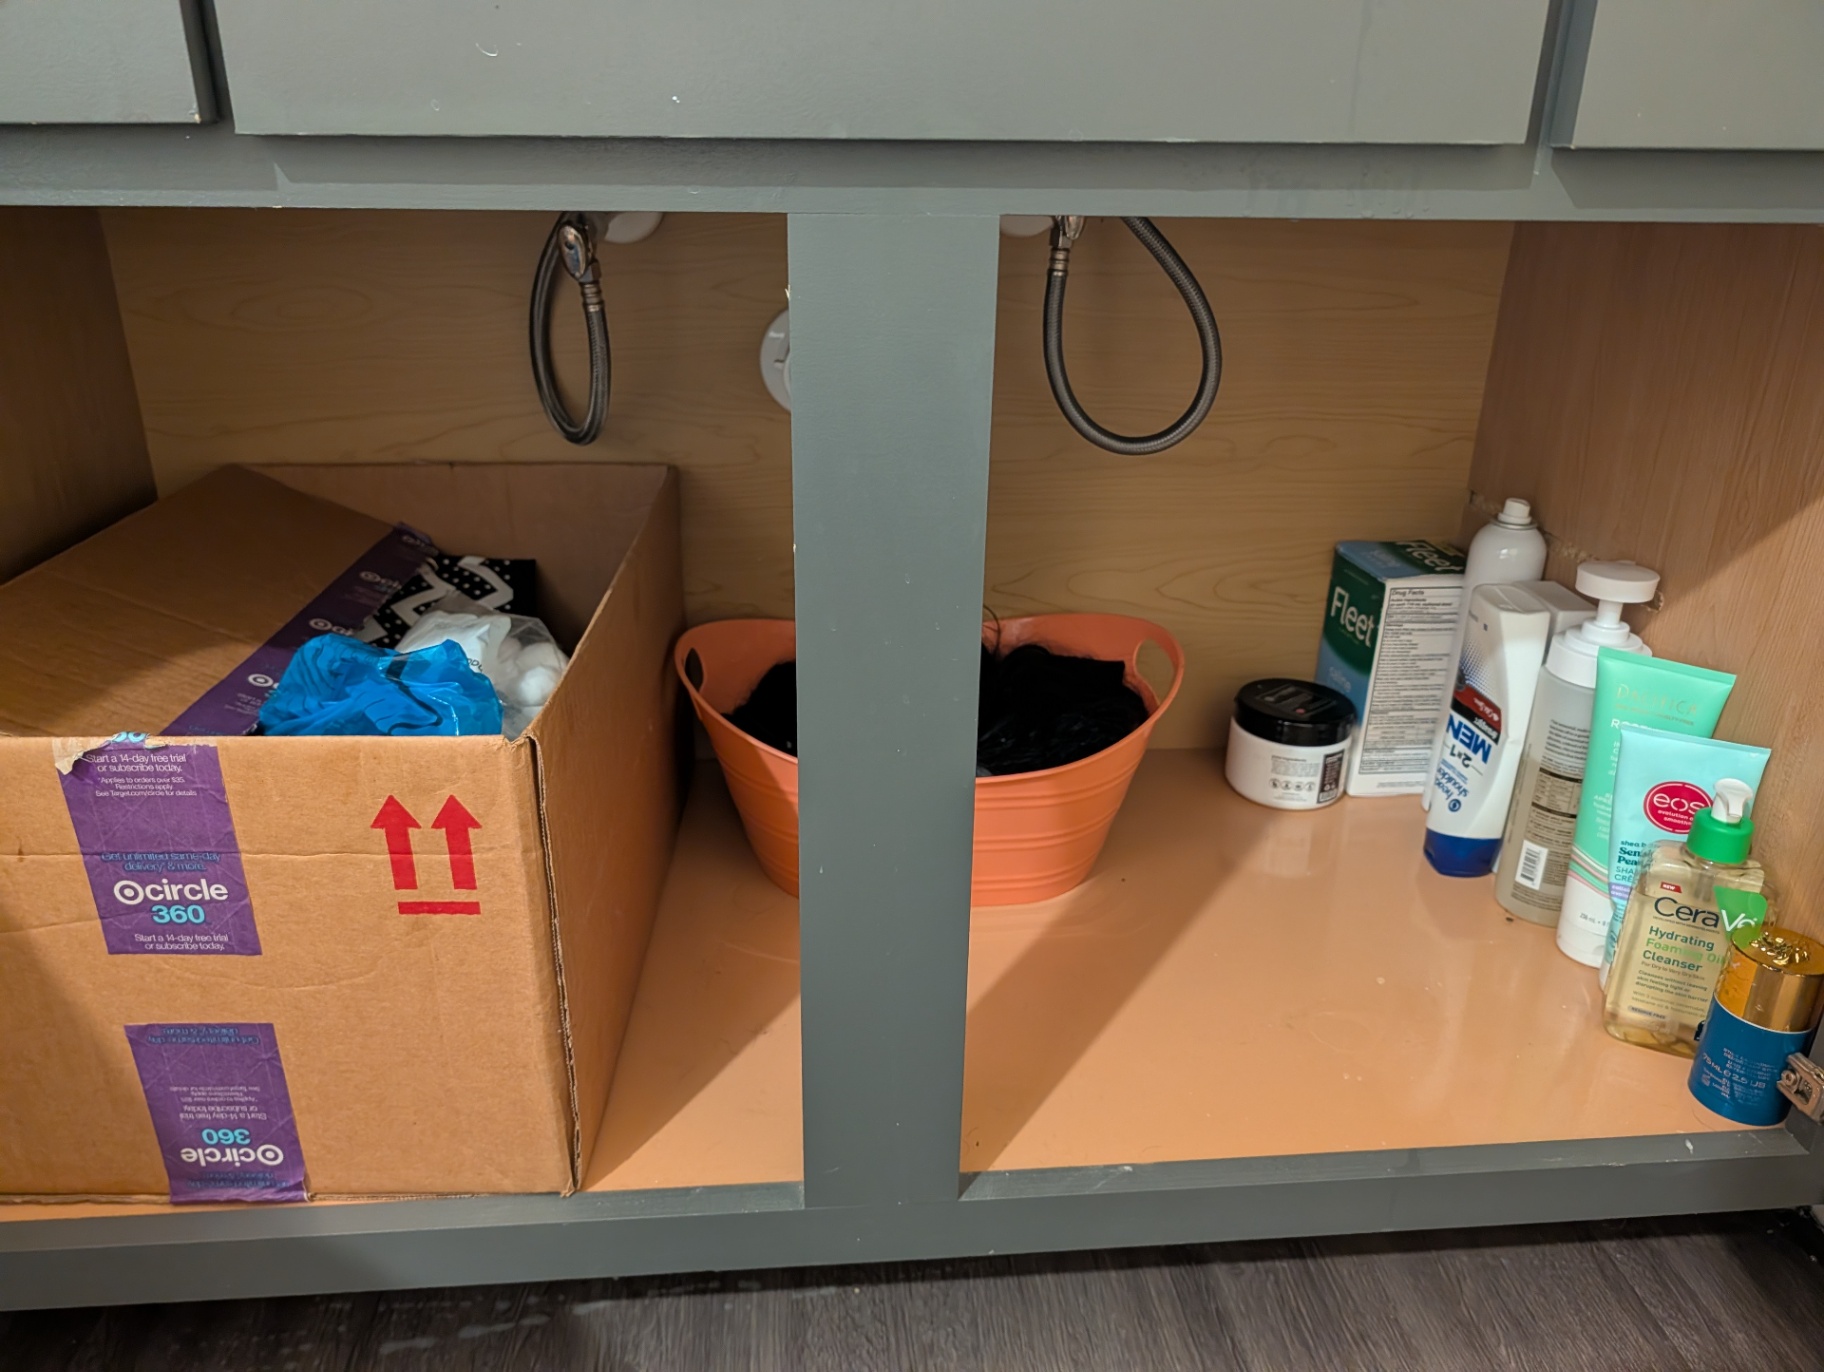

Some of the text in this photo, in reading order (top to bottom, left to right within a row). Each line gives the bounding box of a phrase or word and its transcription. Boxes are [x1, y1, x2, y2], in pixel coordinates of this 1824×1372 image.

[1330, 586, 1375, 649] Fleet
[1446, 713, 1492, 765] MEN
[86, 754, 109, 763] Start
[120, 754, 149, 765] 14-day
[151, 754, 169, 763] free
[170, 753, 186, 763] trial
[109, 763, 154, 773] subscribe
[1653, 793, 1705, 815] eos
[1657, 810, 1689, 820] evolution
[145, 878, 228, 901] circle
[1662, 883, 1676, 891] NEW
[152, 904, 205, 925] 360
[134, 934, 156, 942] Start
[166, 934, 194, 943] 14-day
[195, 934, 212, 942] free
[213, 934, 228, 942] trial
[155, 942, 198, 950] subscribe
[1649, 926, 1714, 951] Hydrating
[1643, 950, 1703, 972] Cleanser
[202, 1128, 250, 1145] 360
[180, 1147, 256, 1167] circle
